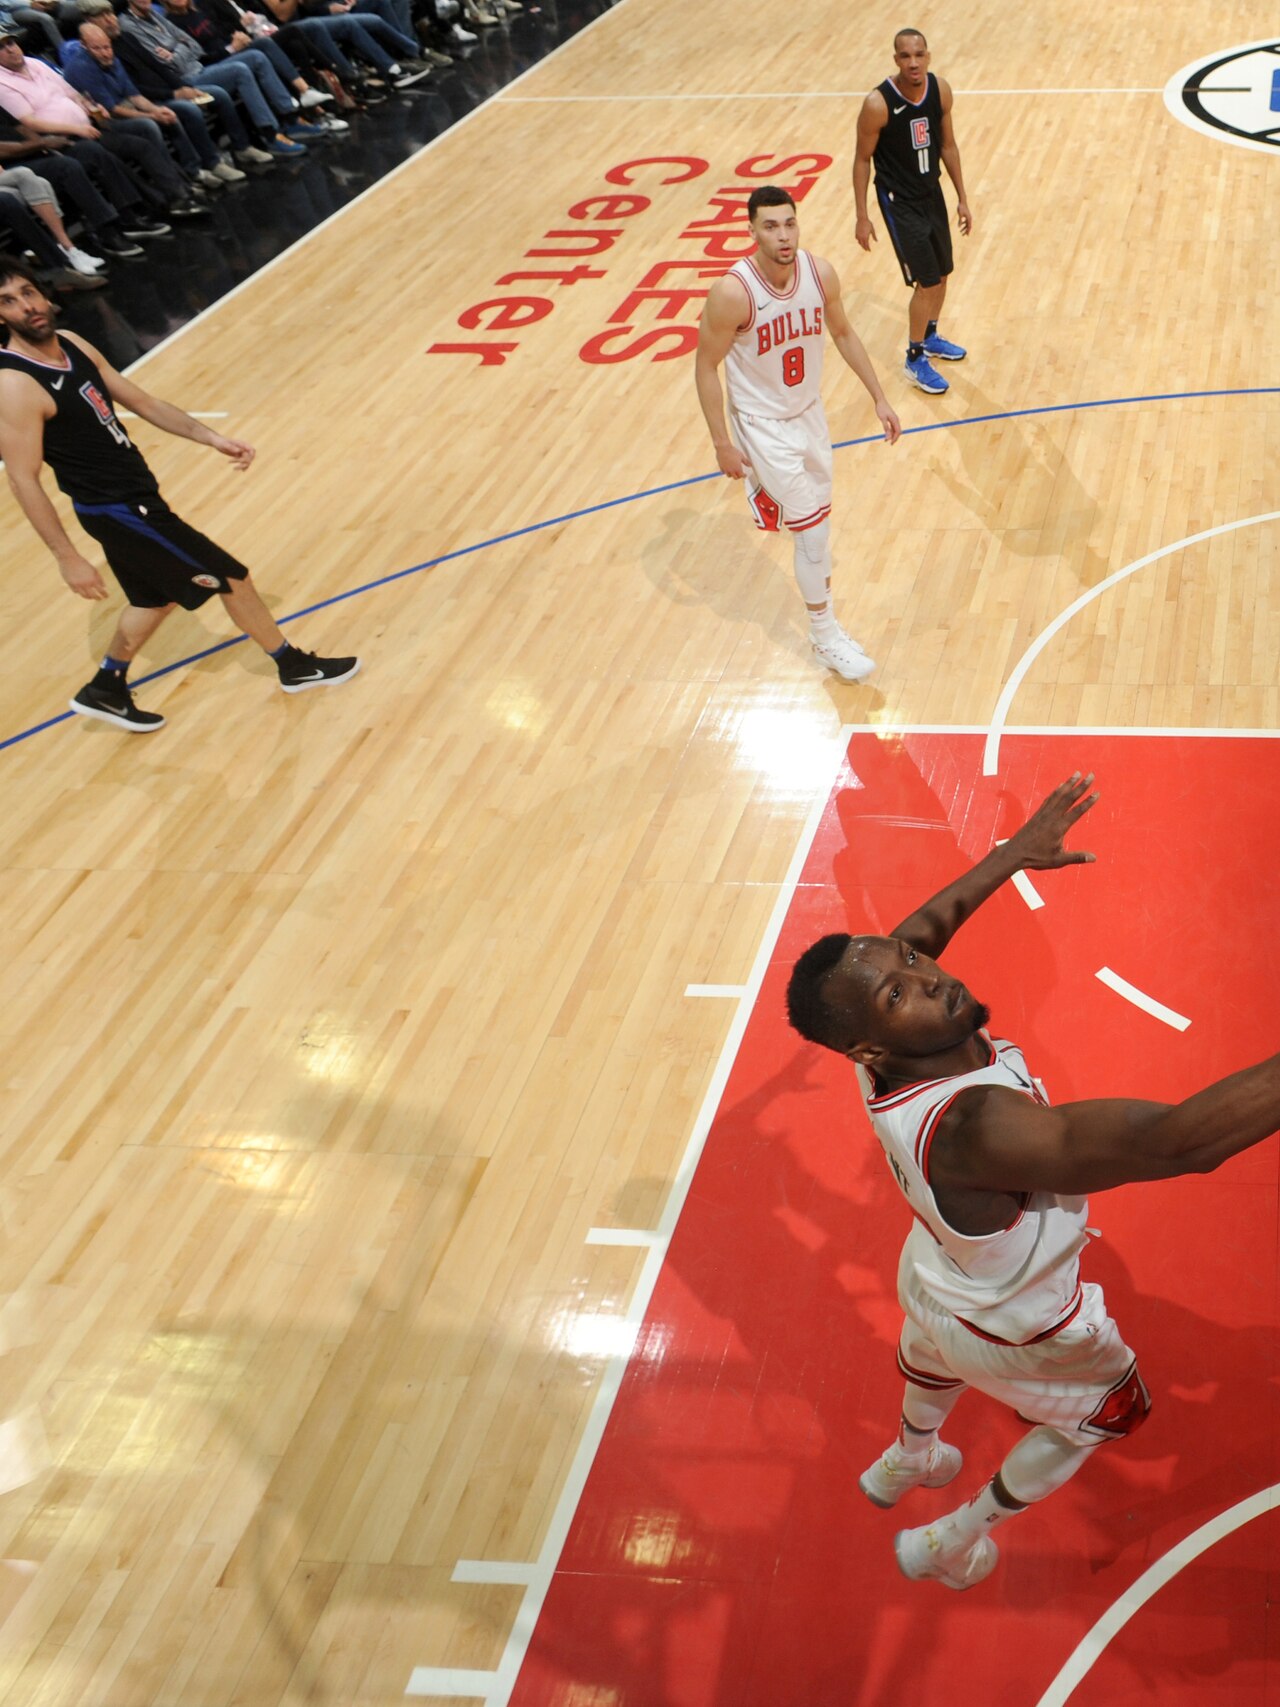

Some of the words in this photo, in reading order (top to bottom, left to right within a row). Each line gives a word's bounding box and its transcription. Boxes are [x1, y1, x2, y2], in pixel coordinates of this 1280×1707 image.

[918, 148, 930, 174] 11
[426, 156, 709, 366] Center
[757, 307, 822, 356] BULLS
[782, 346, 805, 387] 8
